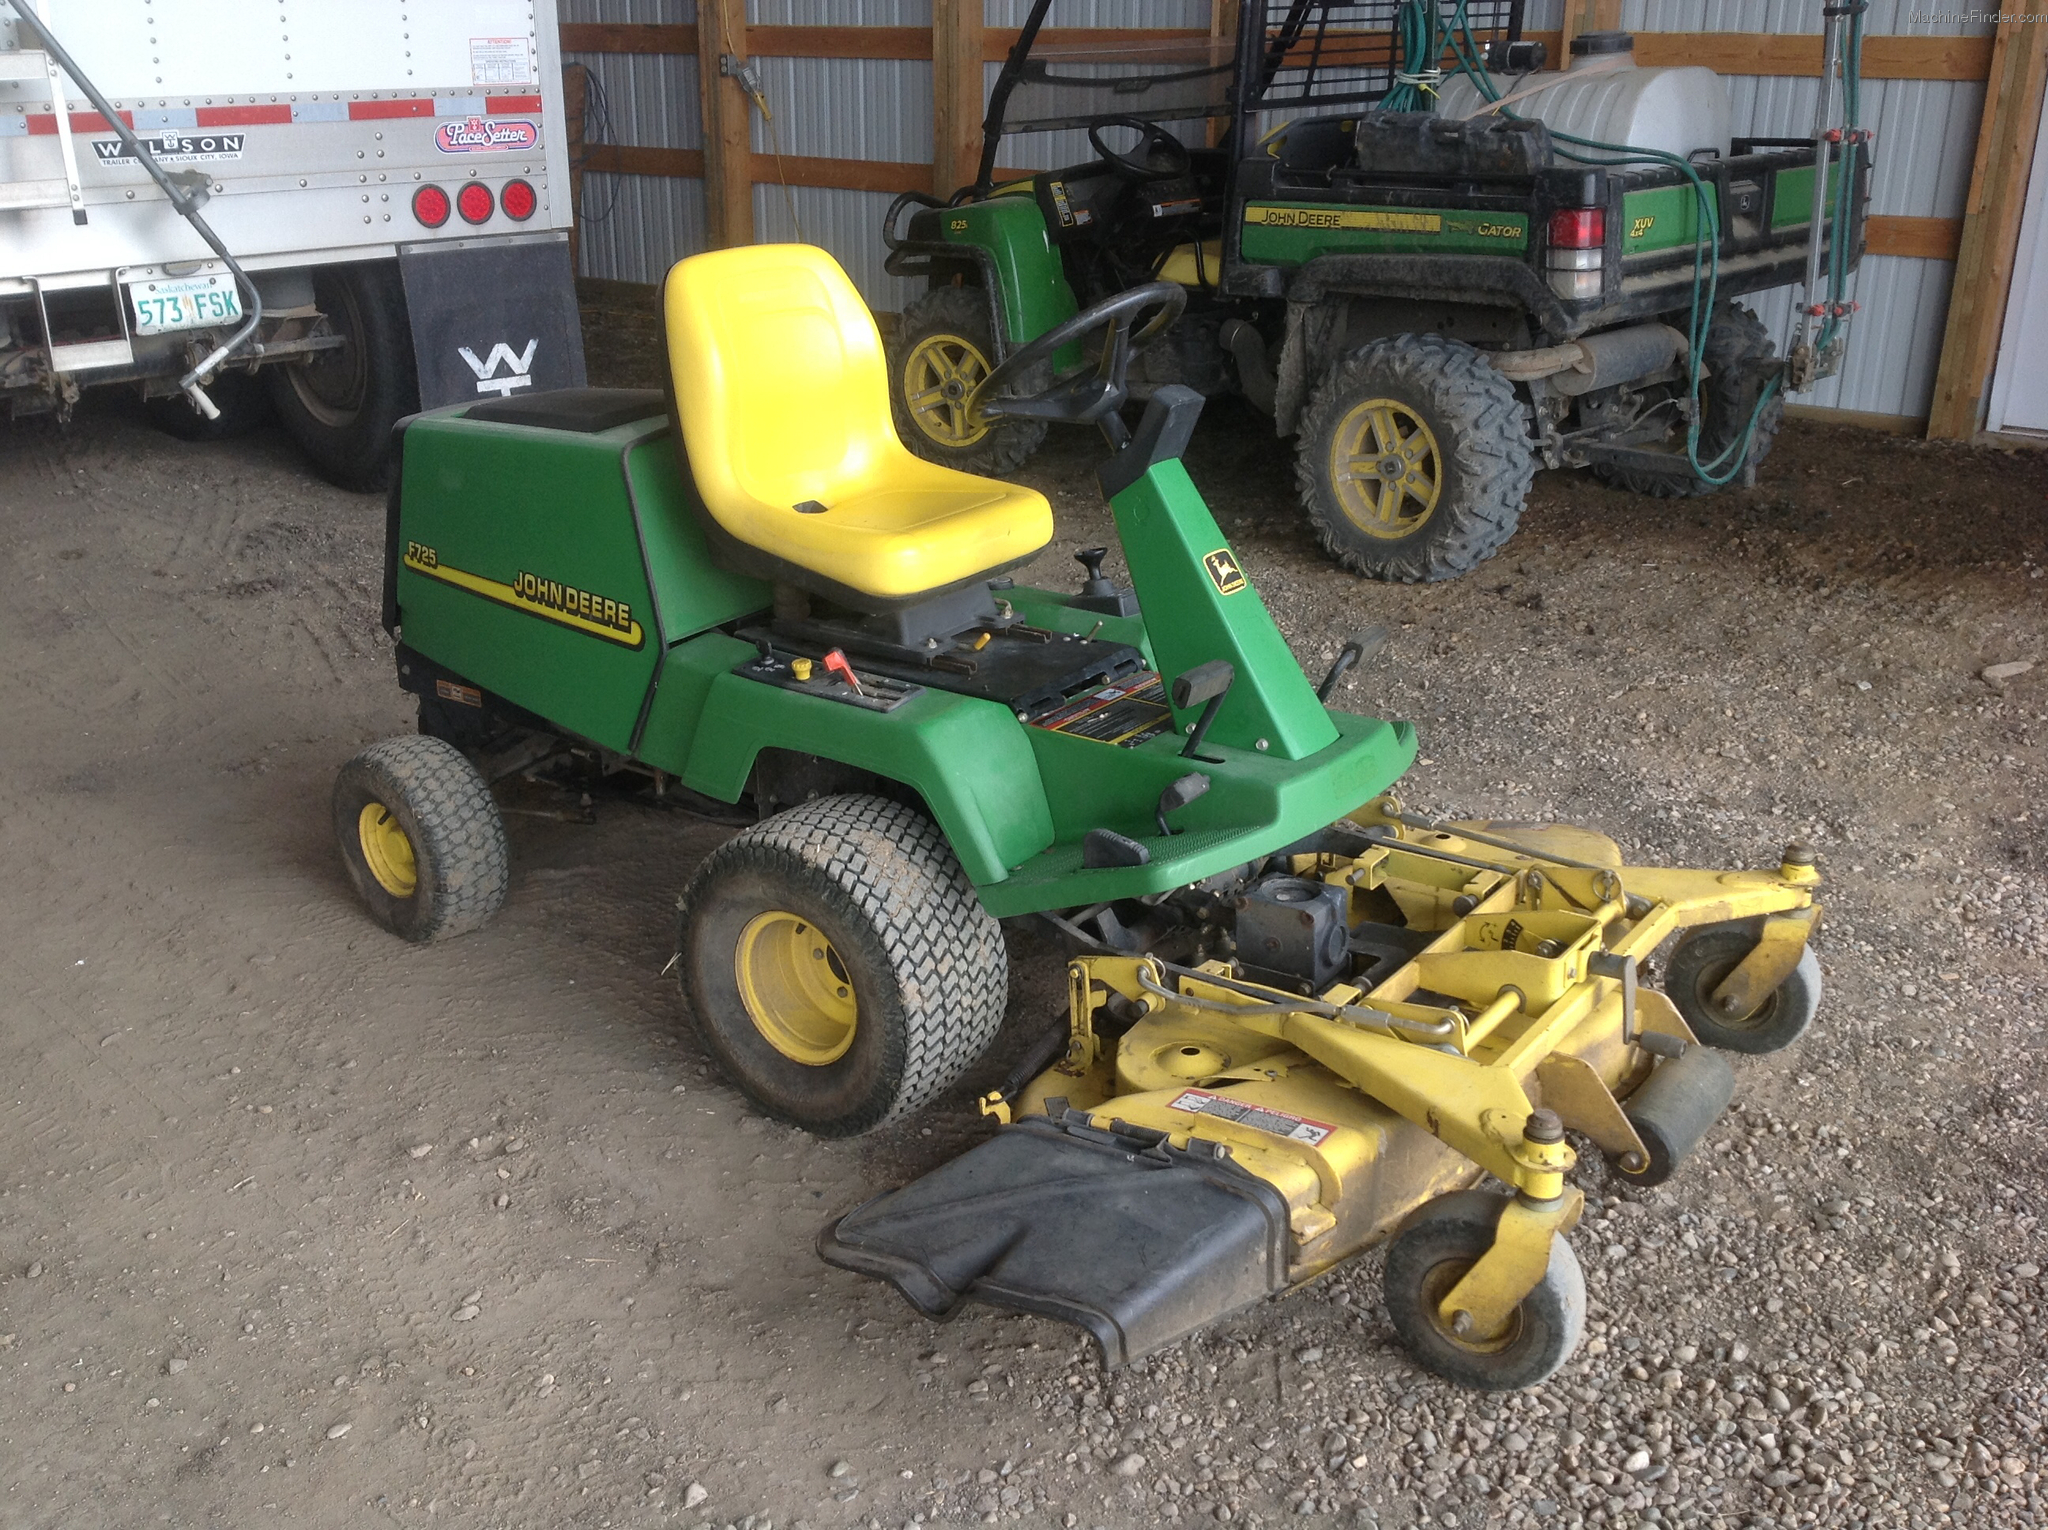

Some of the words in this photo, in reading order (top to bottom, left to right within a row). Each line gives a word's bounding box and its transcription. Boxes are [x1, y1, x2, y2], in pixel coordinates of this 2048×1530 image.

[446, 121, 528, 146] PaceSetter
[98, 136, 240, 157] WLSON
[102, 158, 130, 166] TRAILER
[132, 156, 168, 164] CANY
[1261, 210, 1296, 224] JOHN
[1298, 211, 1341, 226] DEERE
[1634, 217, 1654, 231] XUV
[1478, 222, 1522, 238] GATOR
[138, 296, 182, 326] 573
[194, 290, 239, 319] FSK
[408, 541, 437, 565] F725
[514, 571, 562, 605] JOHN
[565, 587, 630, 627] DEERE
[1218, 1097, 1251, 1109] DANGER
